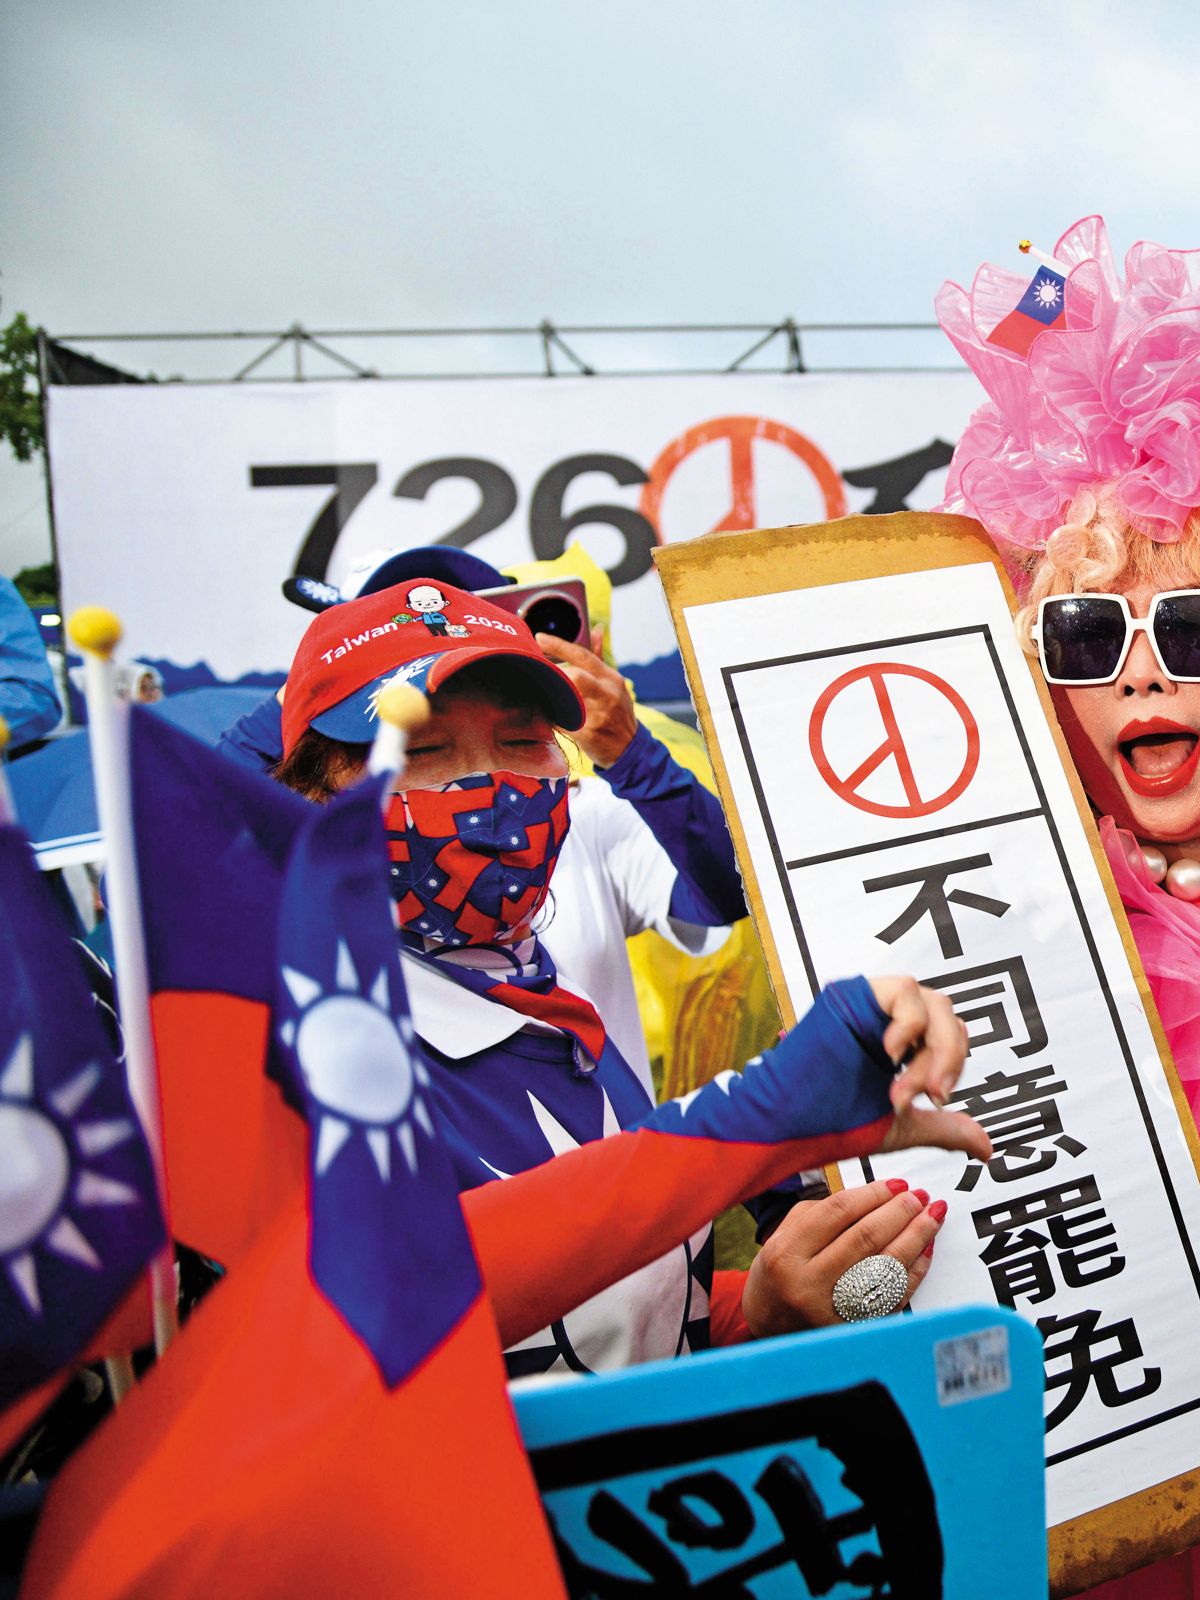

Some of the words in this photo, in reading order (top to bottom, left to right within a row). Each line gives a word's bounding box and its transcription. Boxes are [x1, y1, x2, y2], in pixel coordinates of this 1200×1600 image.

[249, 452, 660, 587] 726
[319, 620, 399, 665] Taiwan
[463, 614, 518, 637] 2020
[862, 852, 1162, 1434] 不同意罷免
